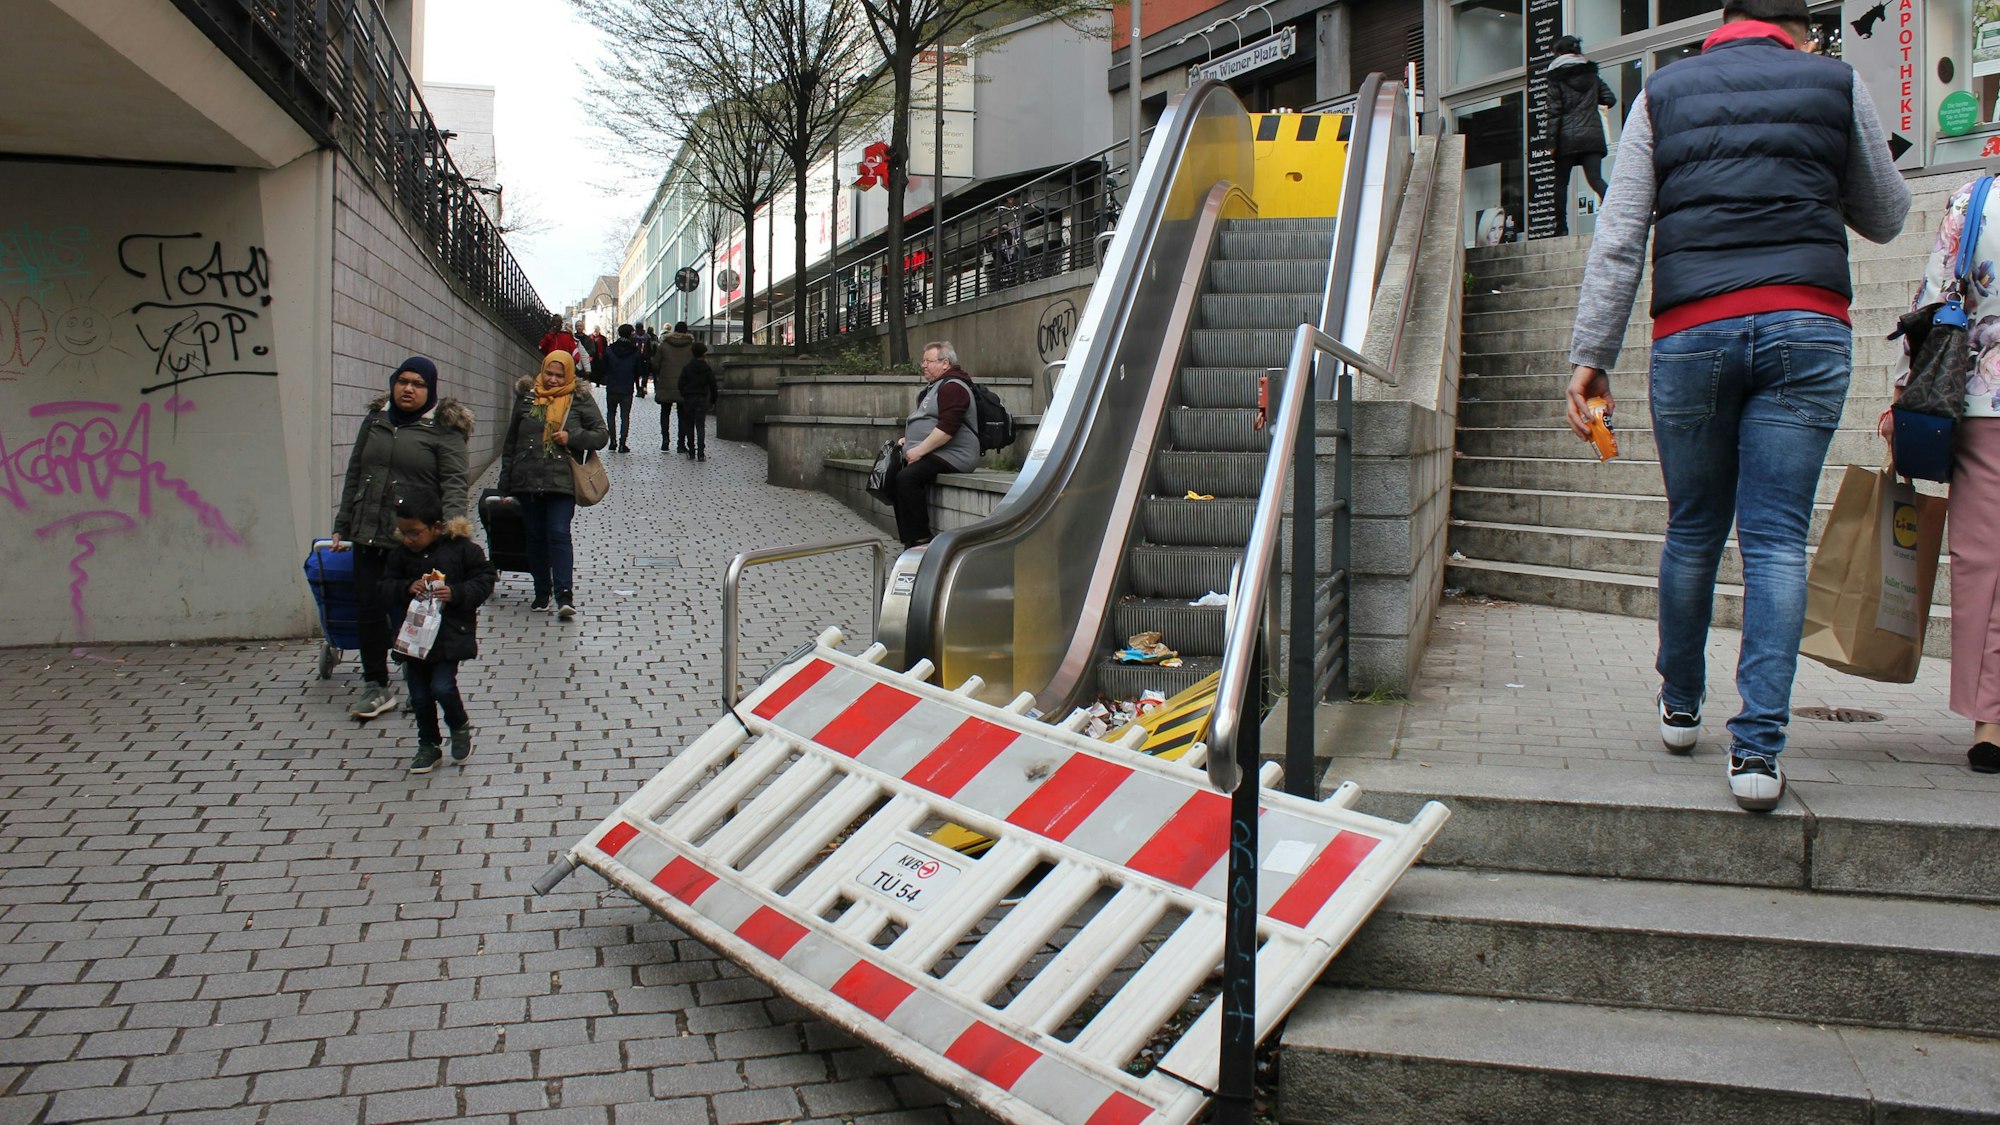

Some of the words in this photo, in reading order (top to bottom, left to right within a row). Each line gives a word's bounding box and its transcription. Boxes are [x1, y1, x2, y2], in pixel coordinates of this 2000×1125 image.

[1203, 70, 1217, 80] Am
[1219, 57, 1251, 78] Wiener
[1253, 45, 1278, 65] Platz
[1899, 0, 1913, 131] APOTHEKE
[898, 854, 924, 870] KVB
[872, 871, 903, 892] TÜ
[896, 883, 922, 903] 54
